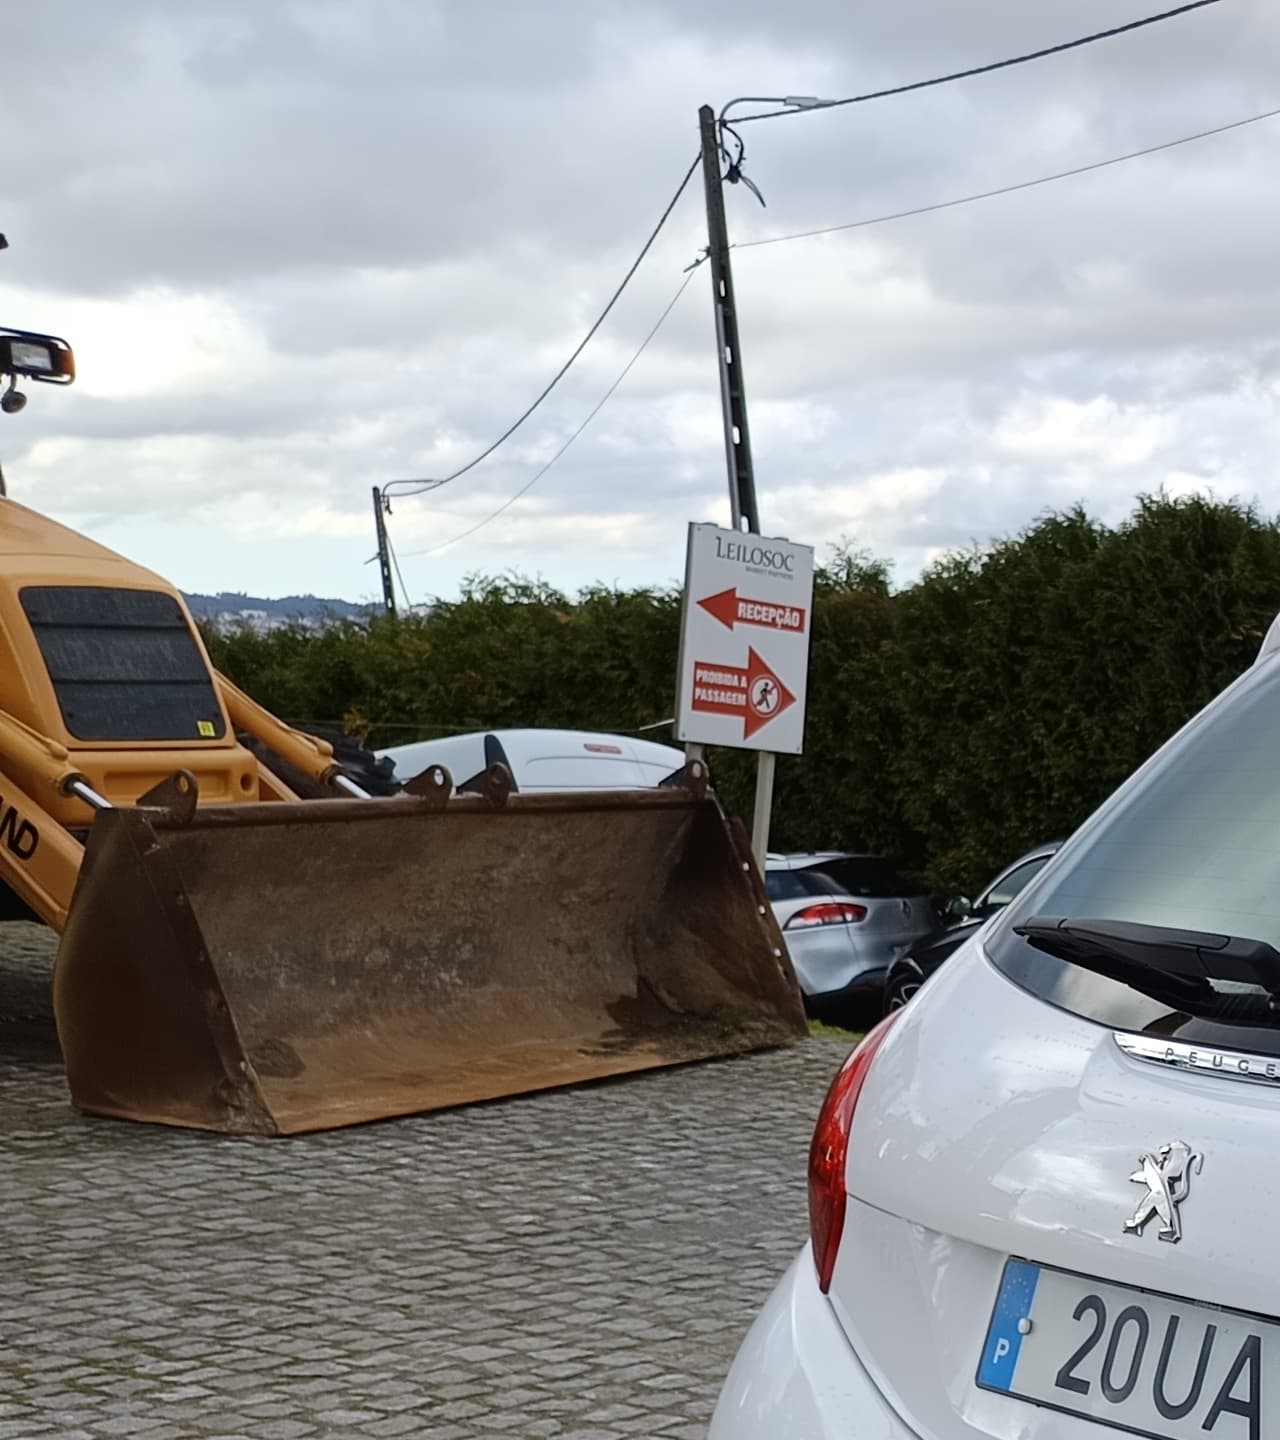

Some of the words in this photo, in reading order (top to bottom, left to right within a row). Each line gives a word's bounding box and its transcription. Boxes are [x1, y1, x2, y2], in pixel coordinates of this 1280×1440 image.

[714, 536, 795, 572] LEILOSOC
[737, 601, 800, 628] RECEPÇÃO
[695, 668, 740, 687] PROIBIDA
[740, 675, 748, 688] A
[694, 687, 747, 706] PASSAGEM
[0, 795, 39, 860] ND
[993, 1337, 1010, 1364] P
